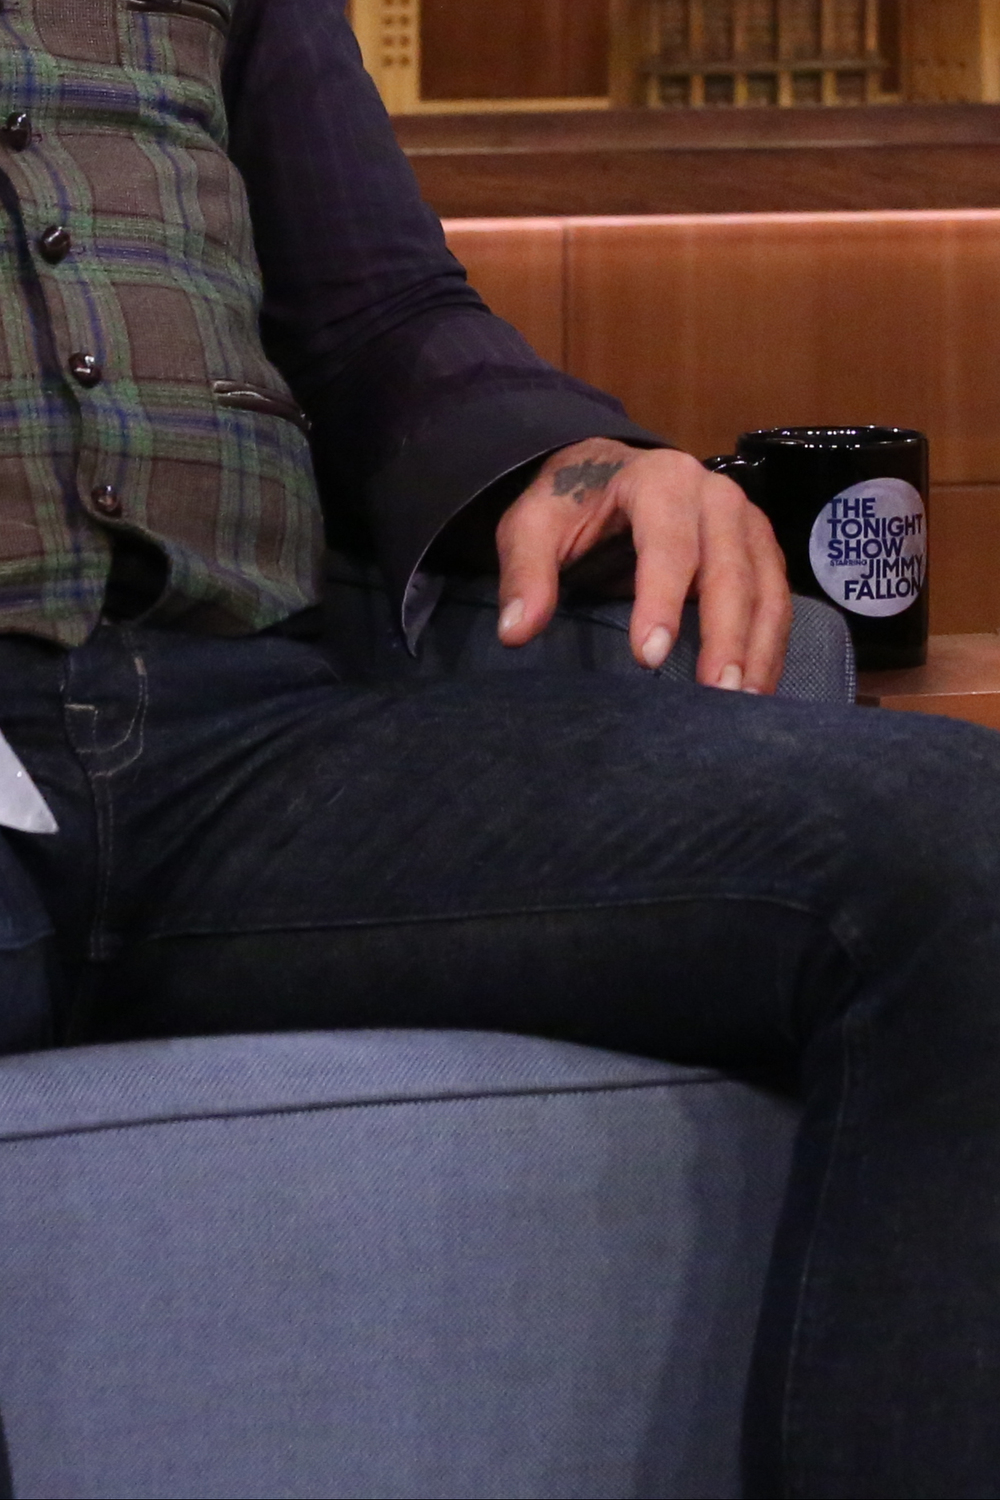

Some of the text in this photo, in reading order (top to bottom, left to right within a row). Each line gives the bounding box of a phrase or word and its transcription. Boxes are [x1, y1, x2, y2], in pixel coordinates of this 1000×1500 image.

[829, 497, 876, 518] THE
[827, 513, 923, 539] TONIGHT
[827, 537, 904, 559] SHOW
[830, 554, 923, 579] STARRING JIMMY
[844, 577, 922, 600] FALLON
